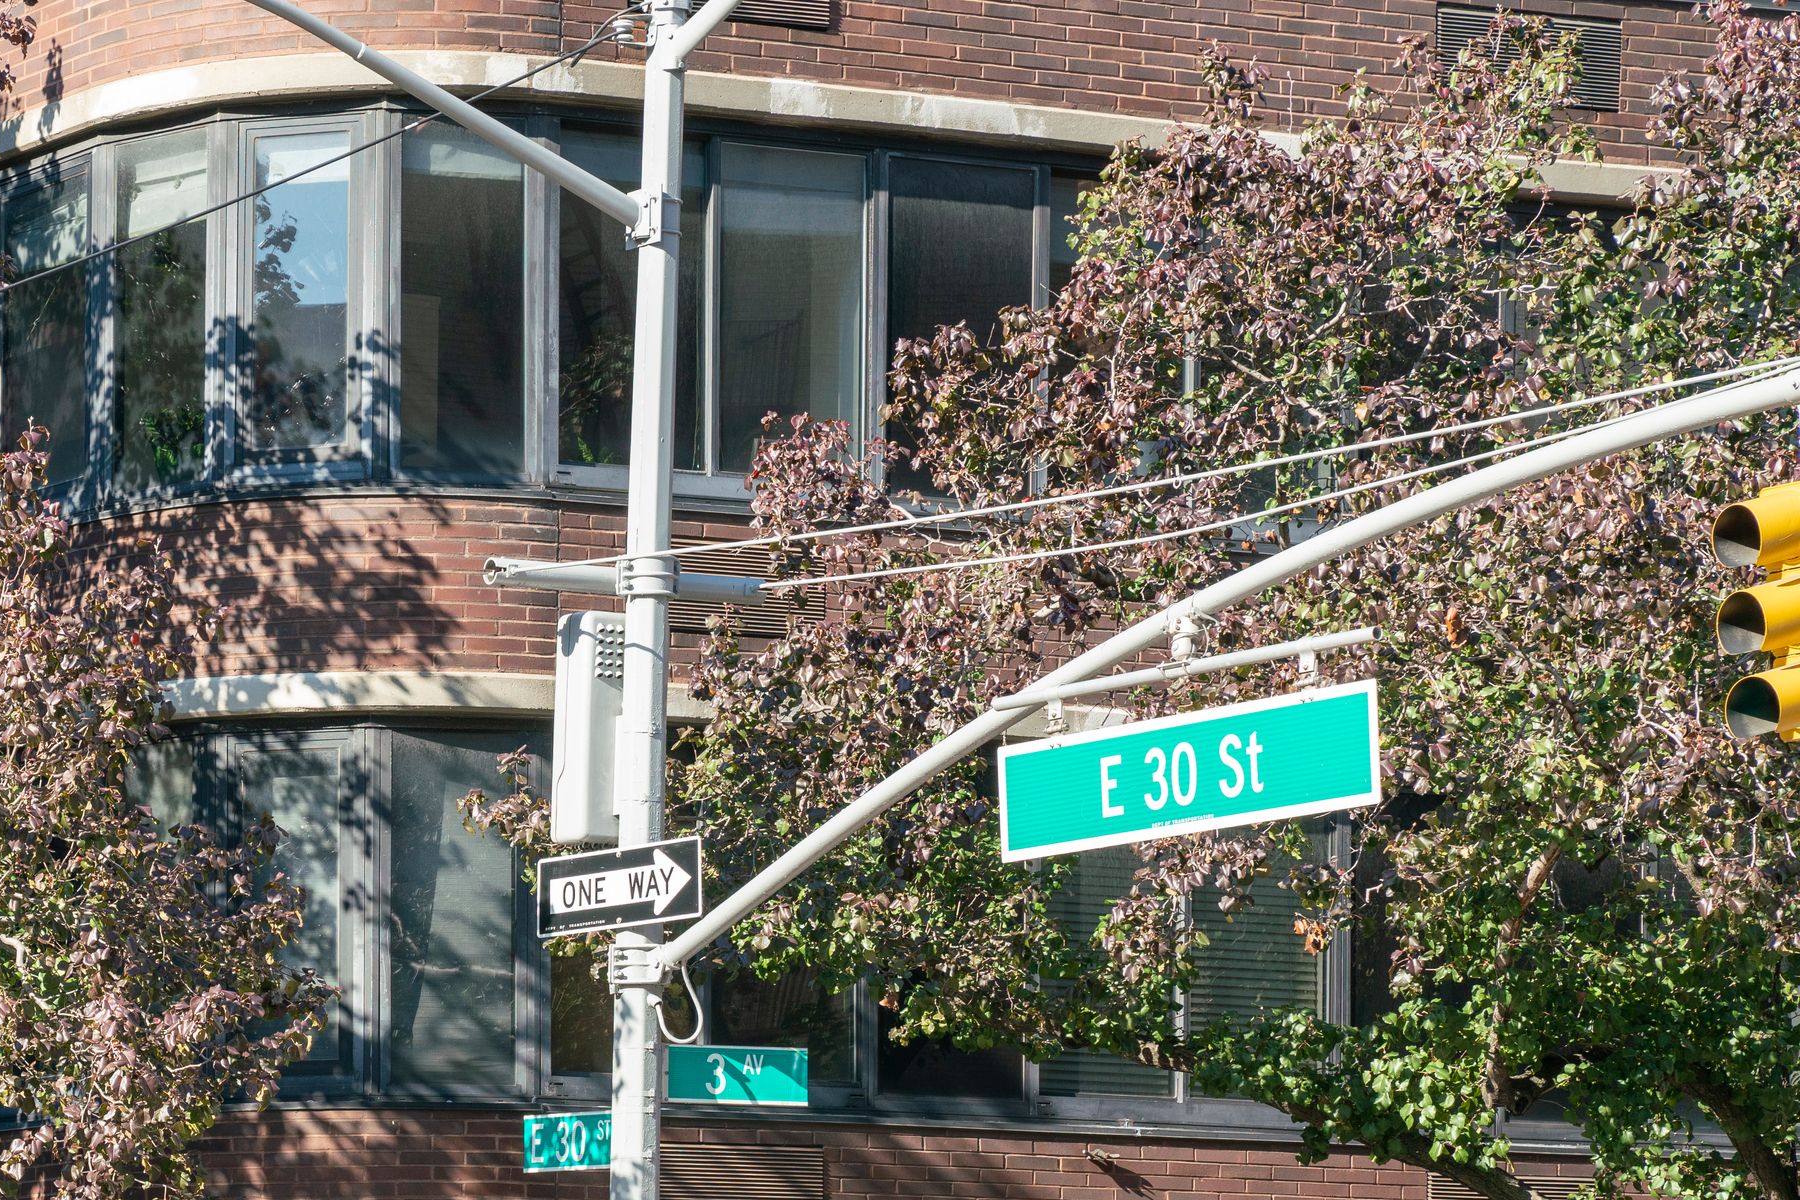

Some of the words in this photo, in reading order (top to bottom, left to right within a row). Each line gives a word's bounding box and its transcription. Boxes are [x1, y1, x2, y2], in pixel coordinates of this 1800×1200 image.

[1100, 754, 1125, 819] E
[1143, 741, 1198, 811] 30
[1218, 730, 1264, 798] St
[563, 877, 606, 908] ONE
[629, 867, 674, 900] WAY
[705, 1053, 727, 1095] 3
[743, 1054, 764, 1075] AV
[531, 1123, 544, 1163] E
[555, 1120, 586, 1163] 30
[597, 1120, 611, 1141] ST
